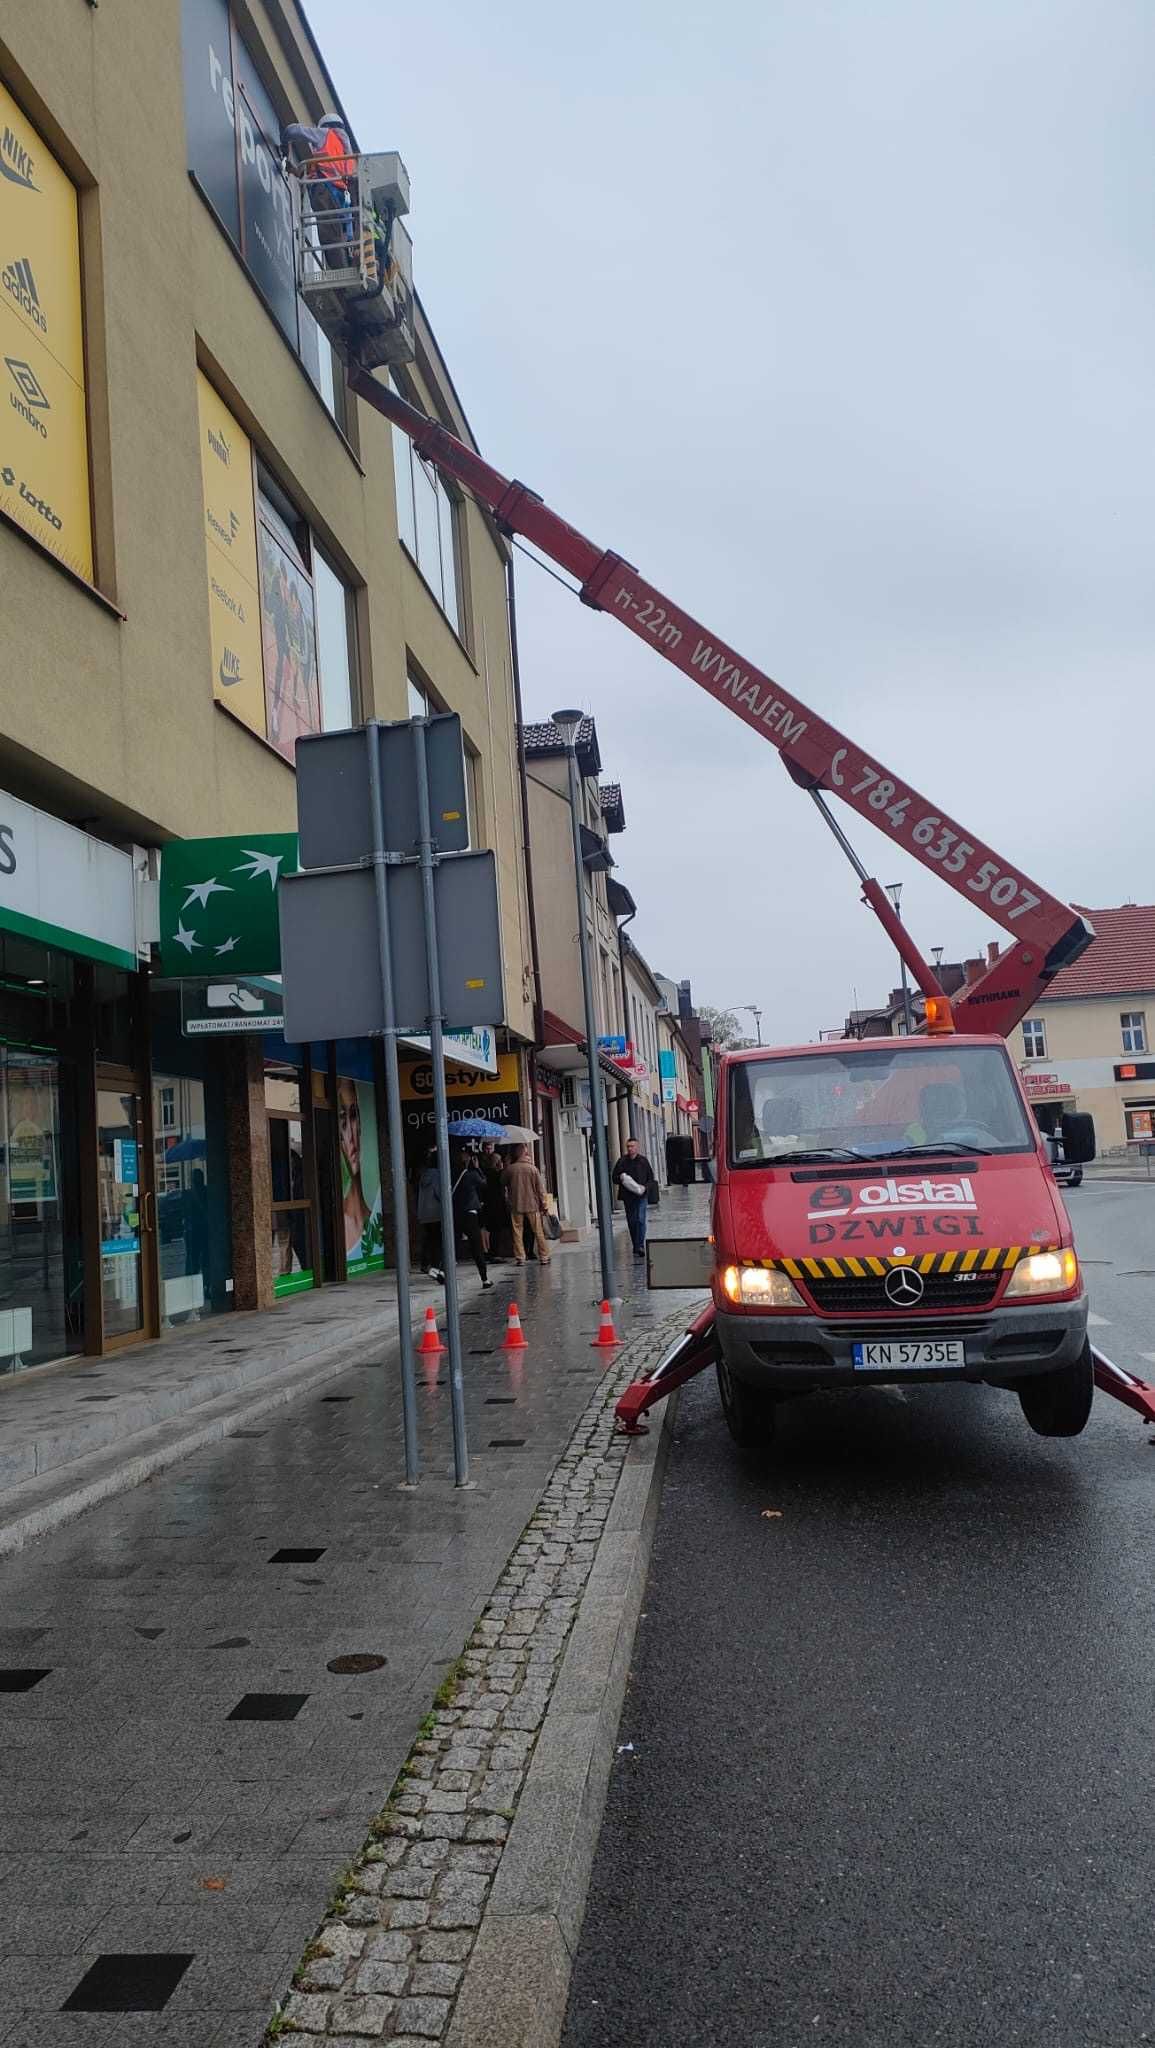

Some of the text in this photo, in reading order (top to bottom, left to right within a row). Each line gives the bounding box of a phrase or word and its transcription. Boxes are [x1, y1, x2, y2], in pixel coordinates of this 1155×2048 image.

[2, 126, 36, 180] NIKE
[2, 270, 48, 333] adidas
[9, 391, 48, 438] umbro
[19, 482, 63, 530] lotto
[223, 647, 241, 679] NIKE
[690, 640, 808, 745] WYNAJEM
[850, 766, 1041, 920] 784 635 507
[859, 1178, 976, 1205] olstal
[808, 1215, 985, 1246] DZWIGI
[866, 1344, 892, 1364] KN
[899, 1342, 959, 1363] 5735E
